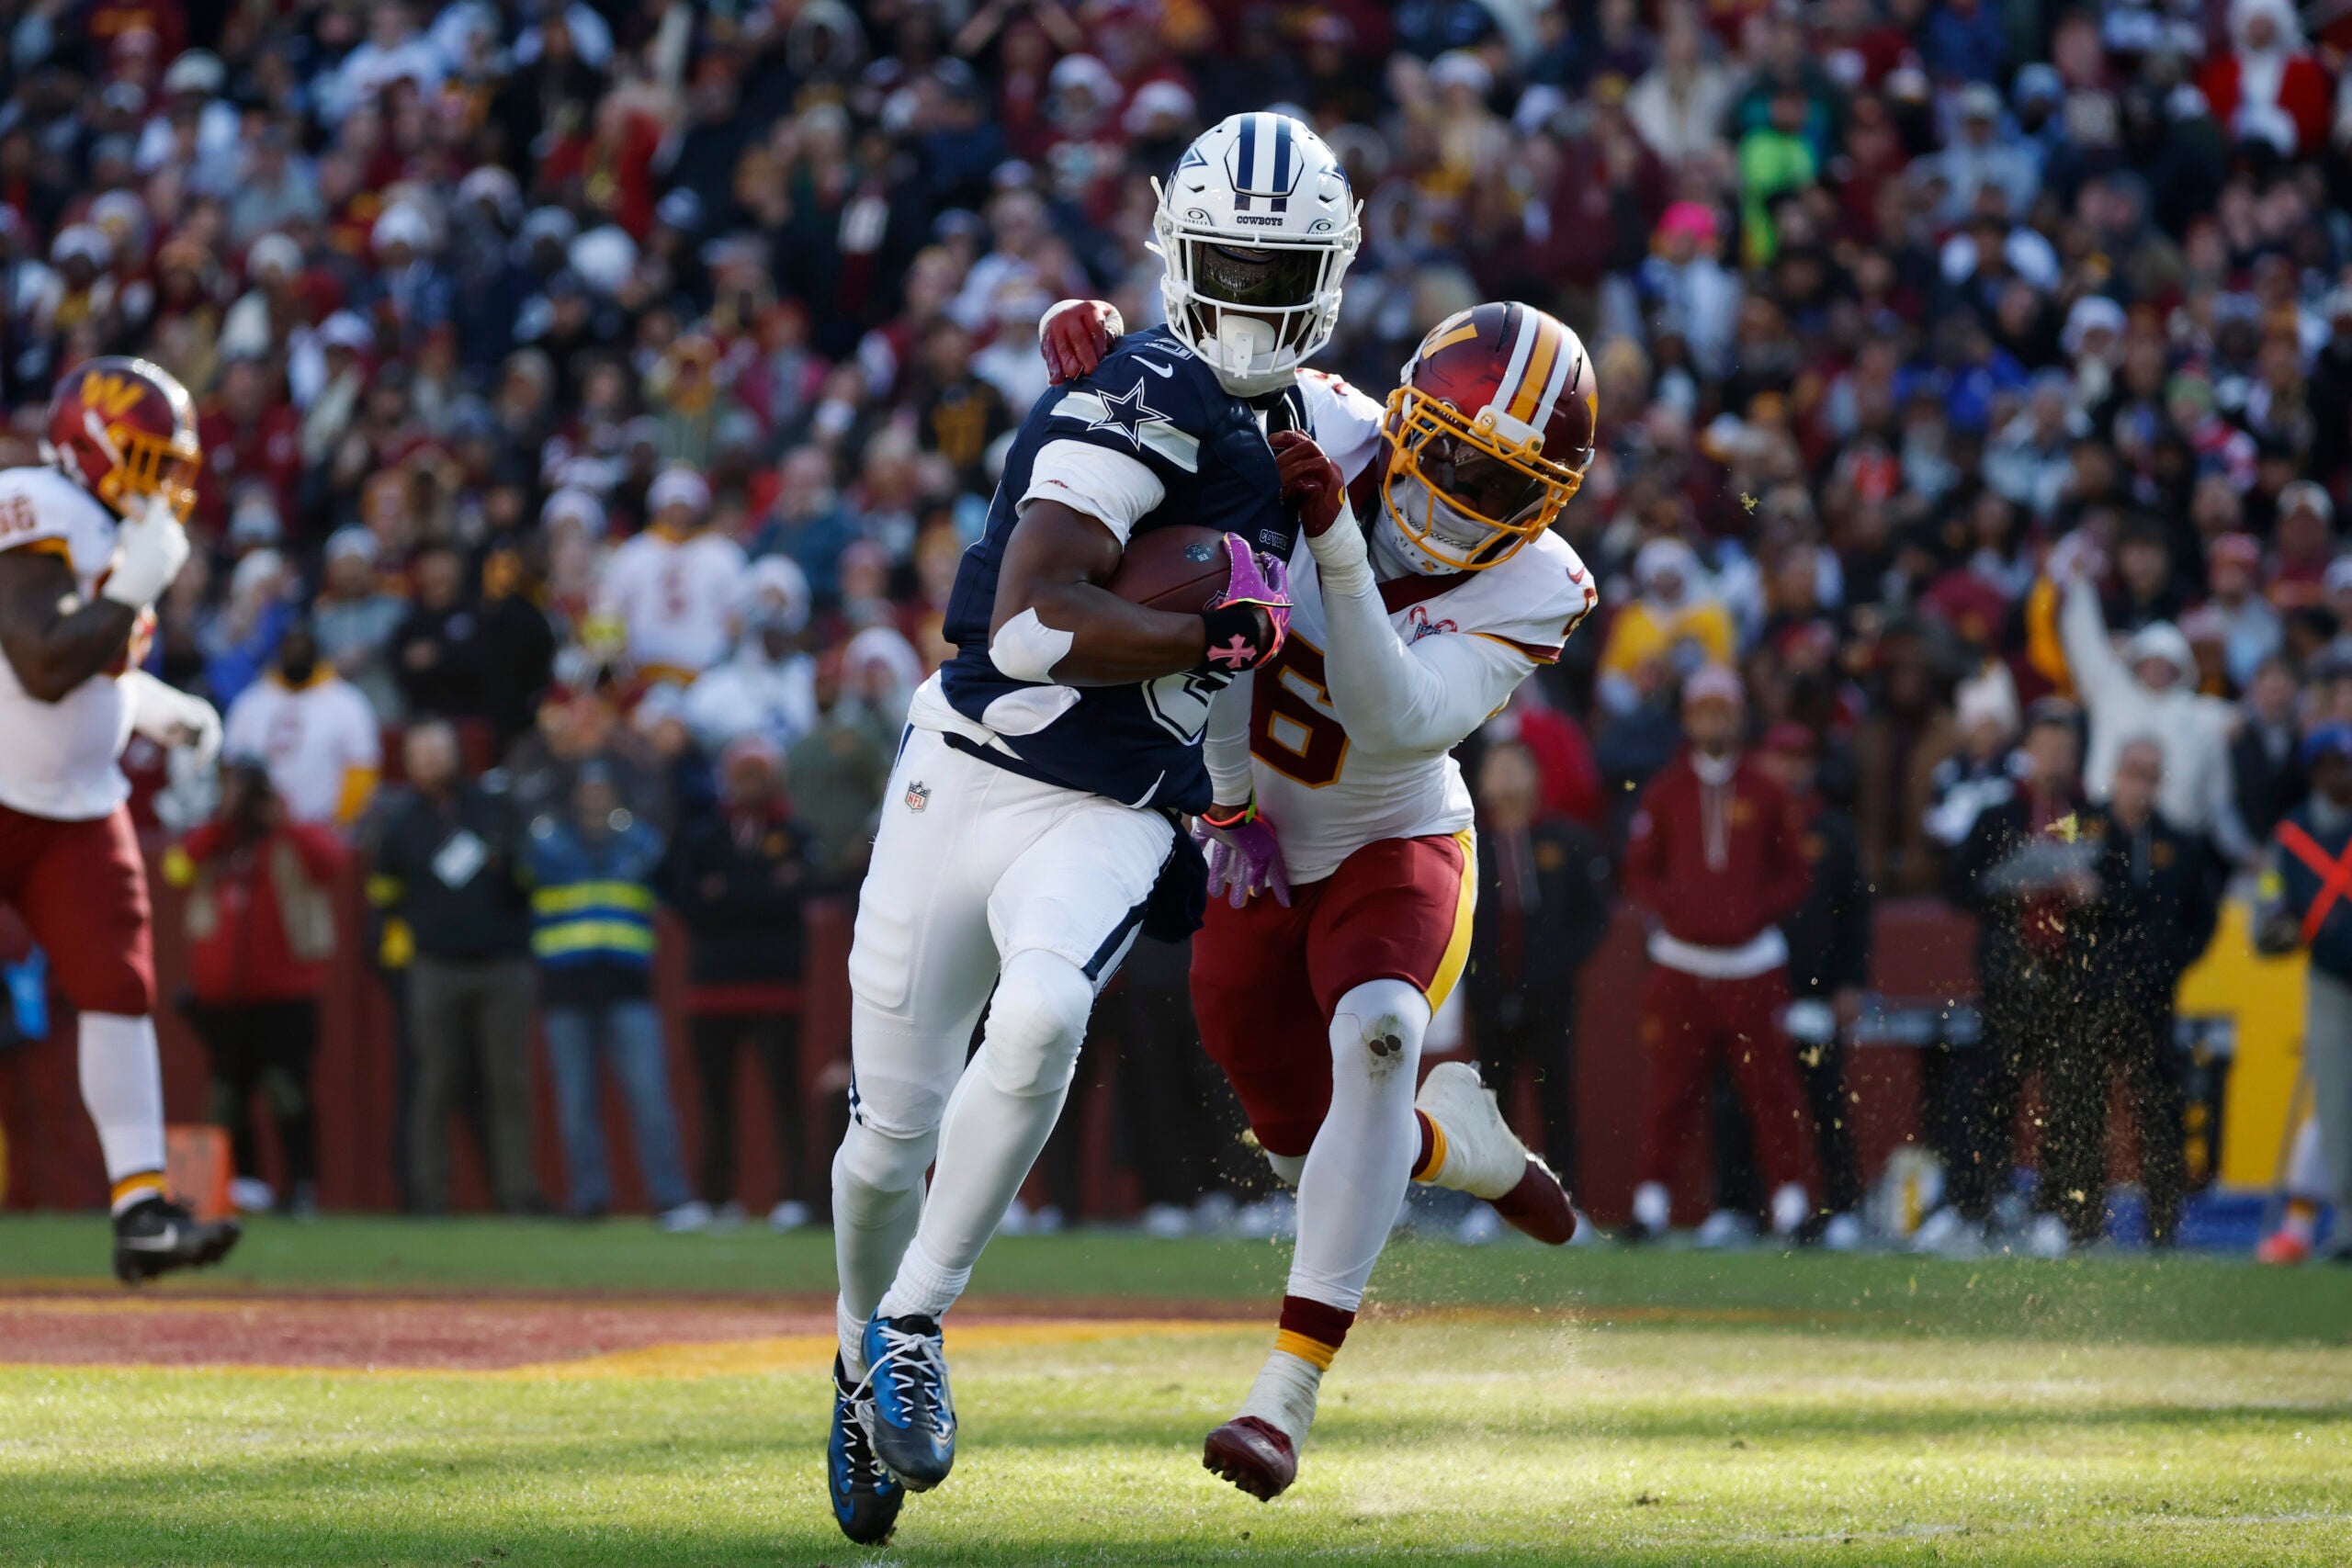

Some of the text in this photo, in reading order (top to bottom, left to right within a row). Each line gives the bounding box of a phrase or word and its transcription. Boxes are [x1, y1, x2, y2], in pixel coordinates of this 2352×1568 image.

[1236, 215, 1283, 227] COWBOYS
[1250, 627, 1351, 790] 6
[908, 792, 922, 808] NFL
